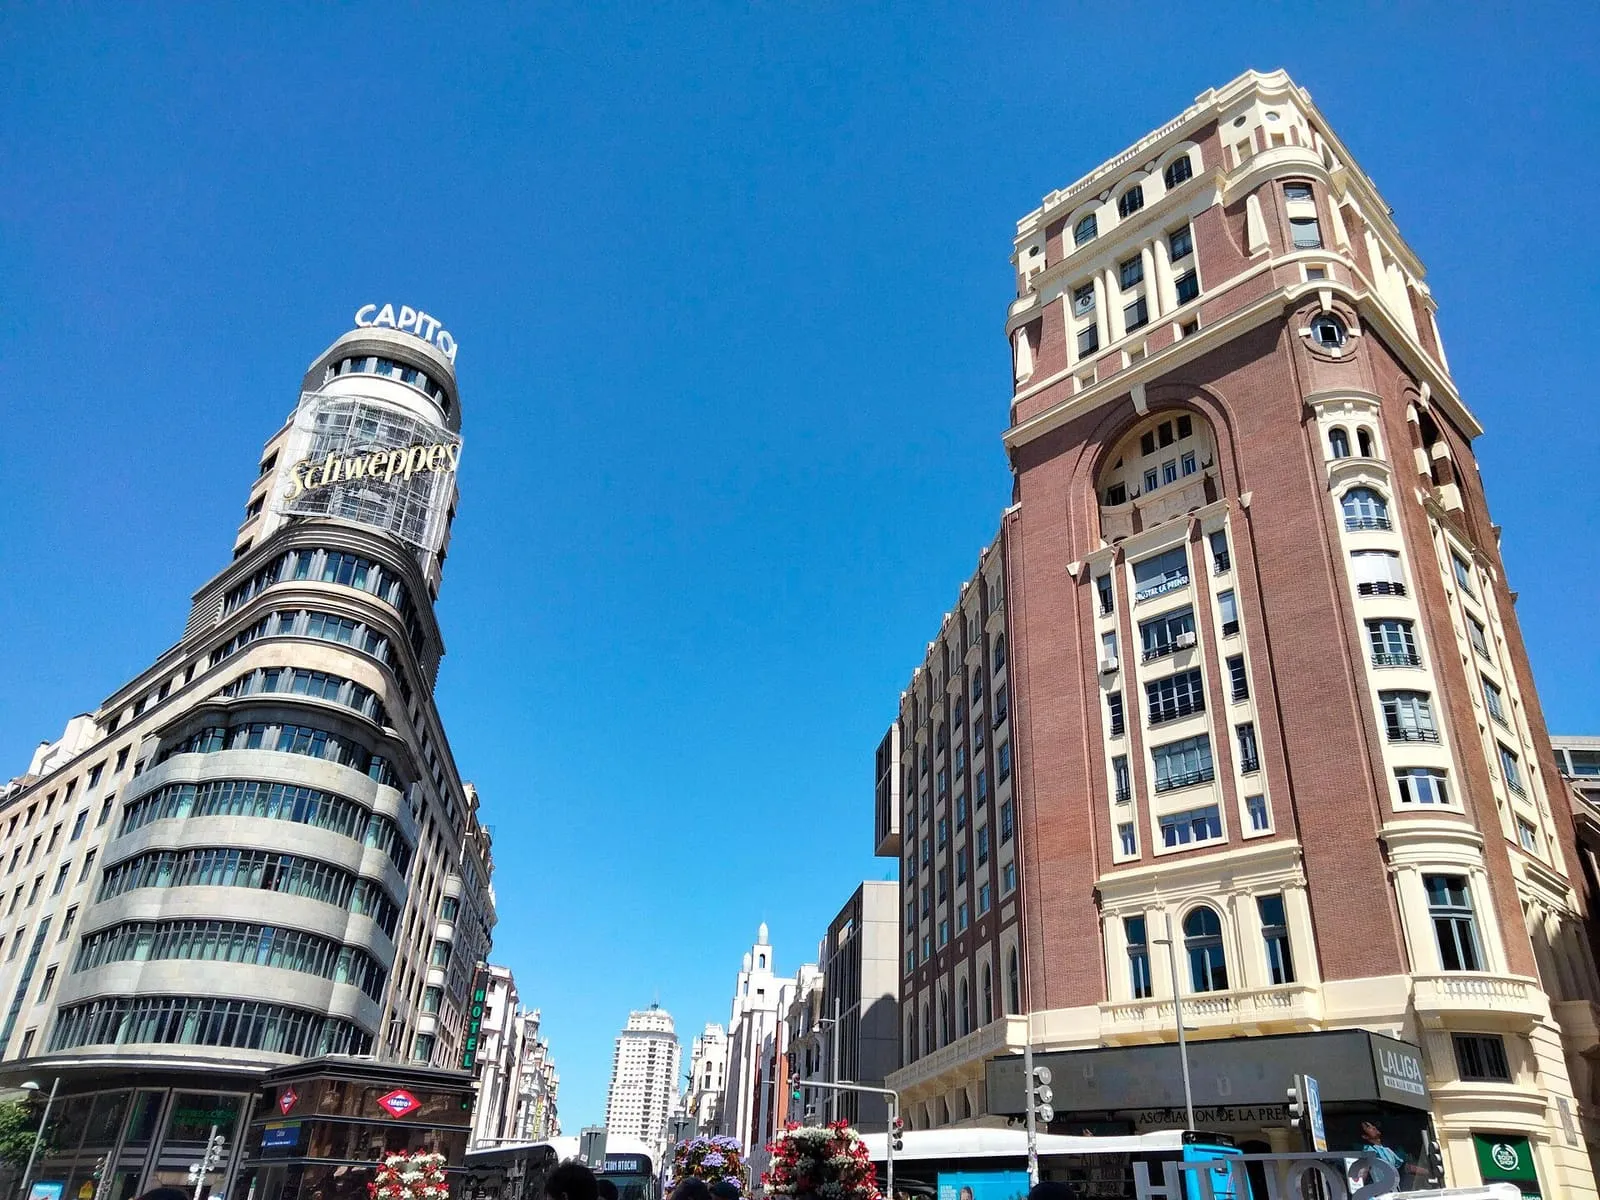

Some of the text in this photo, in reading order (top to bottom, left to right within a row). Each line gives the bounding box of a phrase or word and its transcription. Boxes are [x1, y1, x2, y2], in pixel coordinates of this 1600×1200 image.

[284, 441, 459, 500] Schweppes
[463, 989, 485, 1067] HOTEL
[1378, 1048, 1422, 1082] LALIGA
[390, 1098, 409, 1107] Metro
[1239, 1108, 1256, 1121] LA
[604, 1160, 618, 1170] CION
